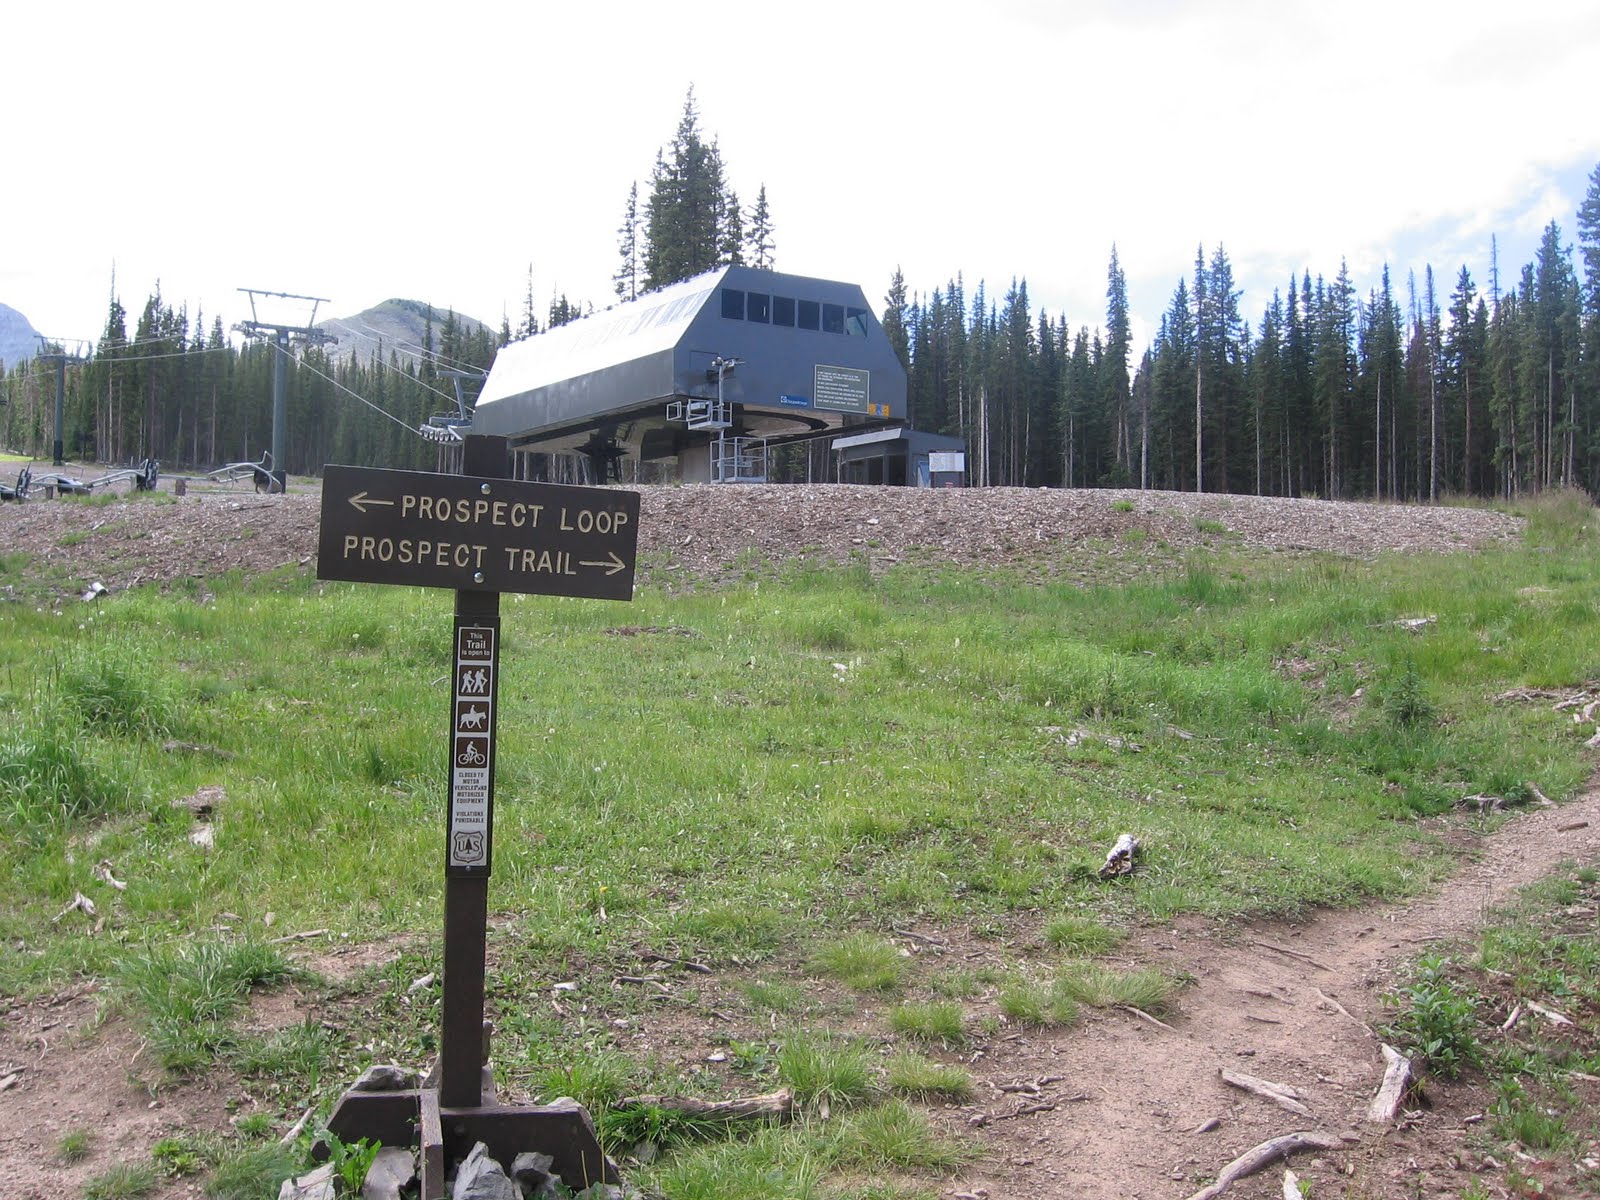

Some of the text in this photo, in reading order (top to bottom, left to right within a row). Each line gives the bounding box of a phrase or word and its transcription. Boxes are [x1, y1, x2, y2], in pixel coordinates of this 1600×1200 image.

[401, 494, 628, 535] PROSPECT LOOP
[343, 535, 577, 575] PROSPECT TRAIL
[466, 640, 486, 649] Trail
